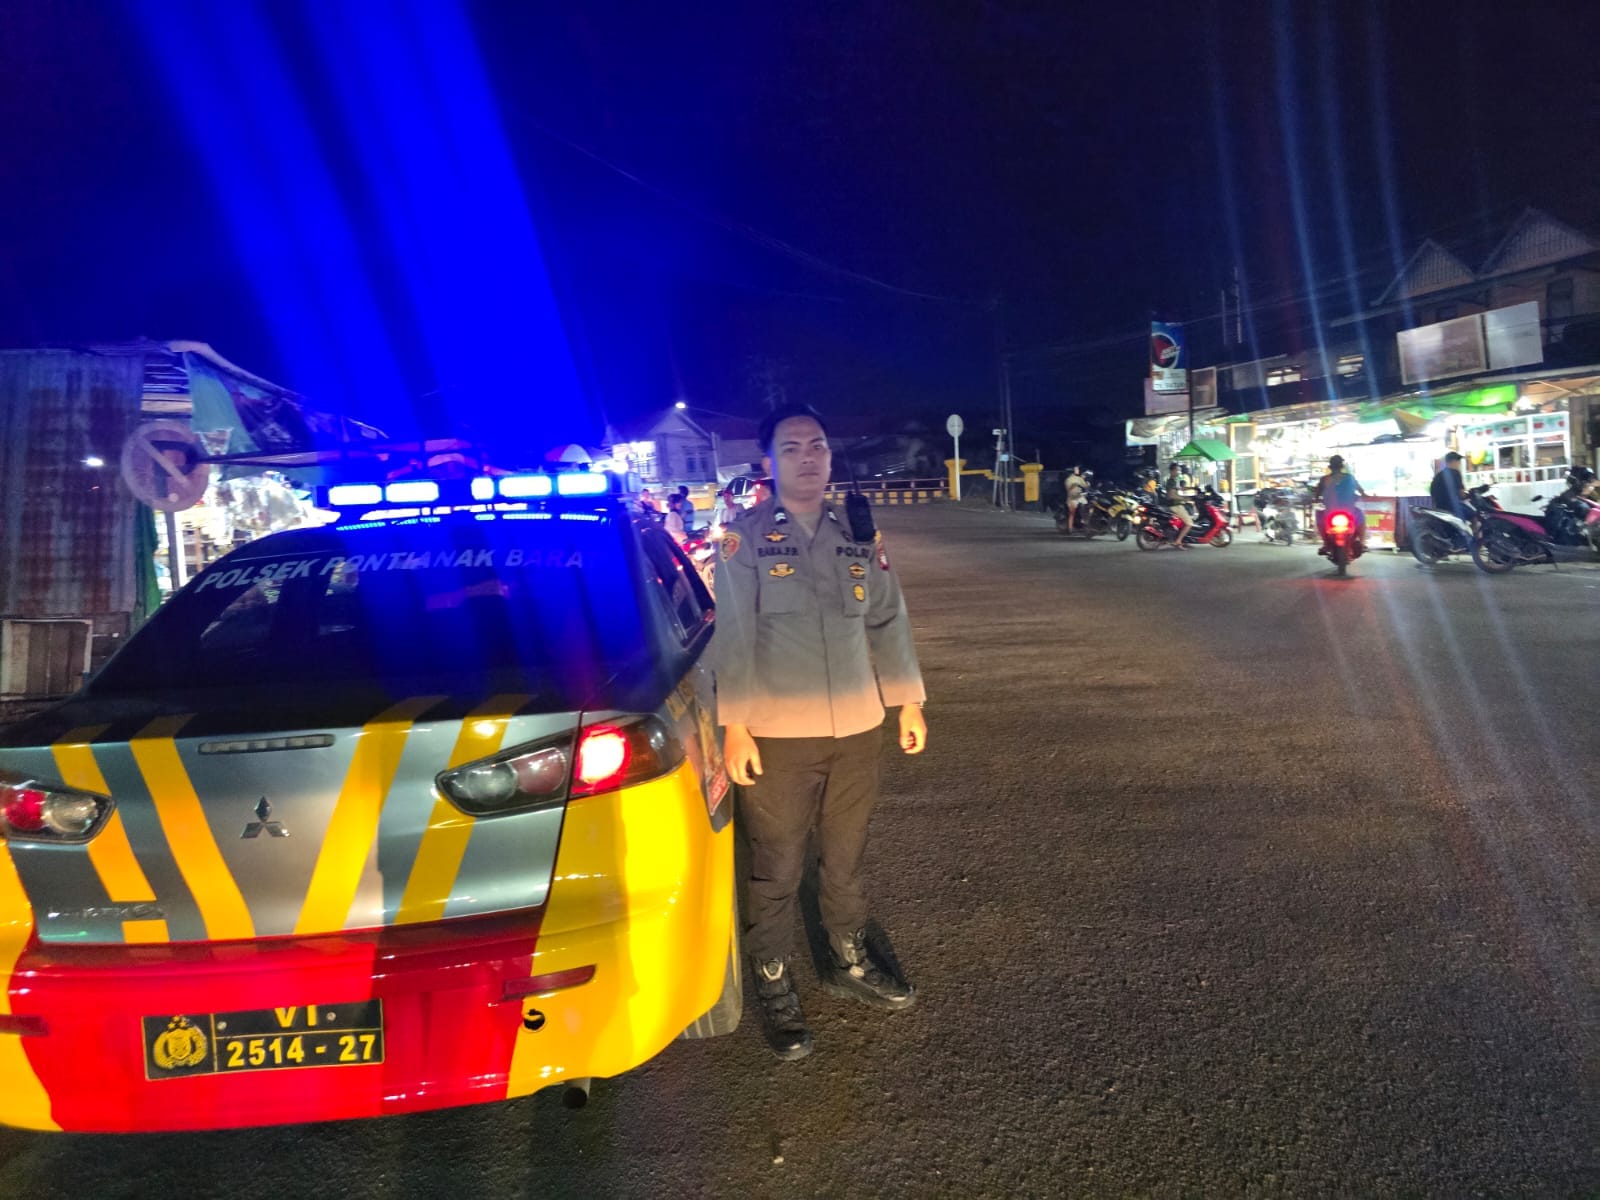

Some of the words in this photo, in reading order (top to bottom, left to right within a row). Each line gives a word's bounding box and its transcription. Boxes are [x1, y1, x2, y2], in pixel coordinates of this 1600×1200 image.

[195, 558, 320, 593] POLSEK
[320, 550, 496, 576] PONTIANAK
[505, 549, 585, 569] BARA
[227, 1036, 304, 1067] 2514
[339, 1034, 376, 1061] 27
